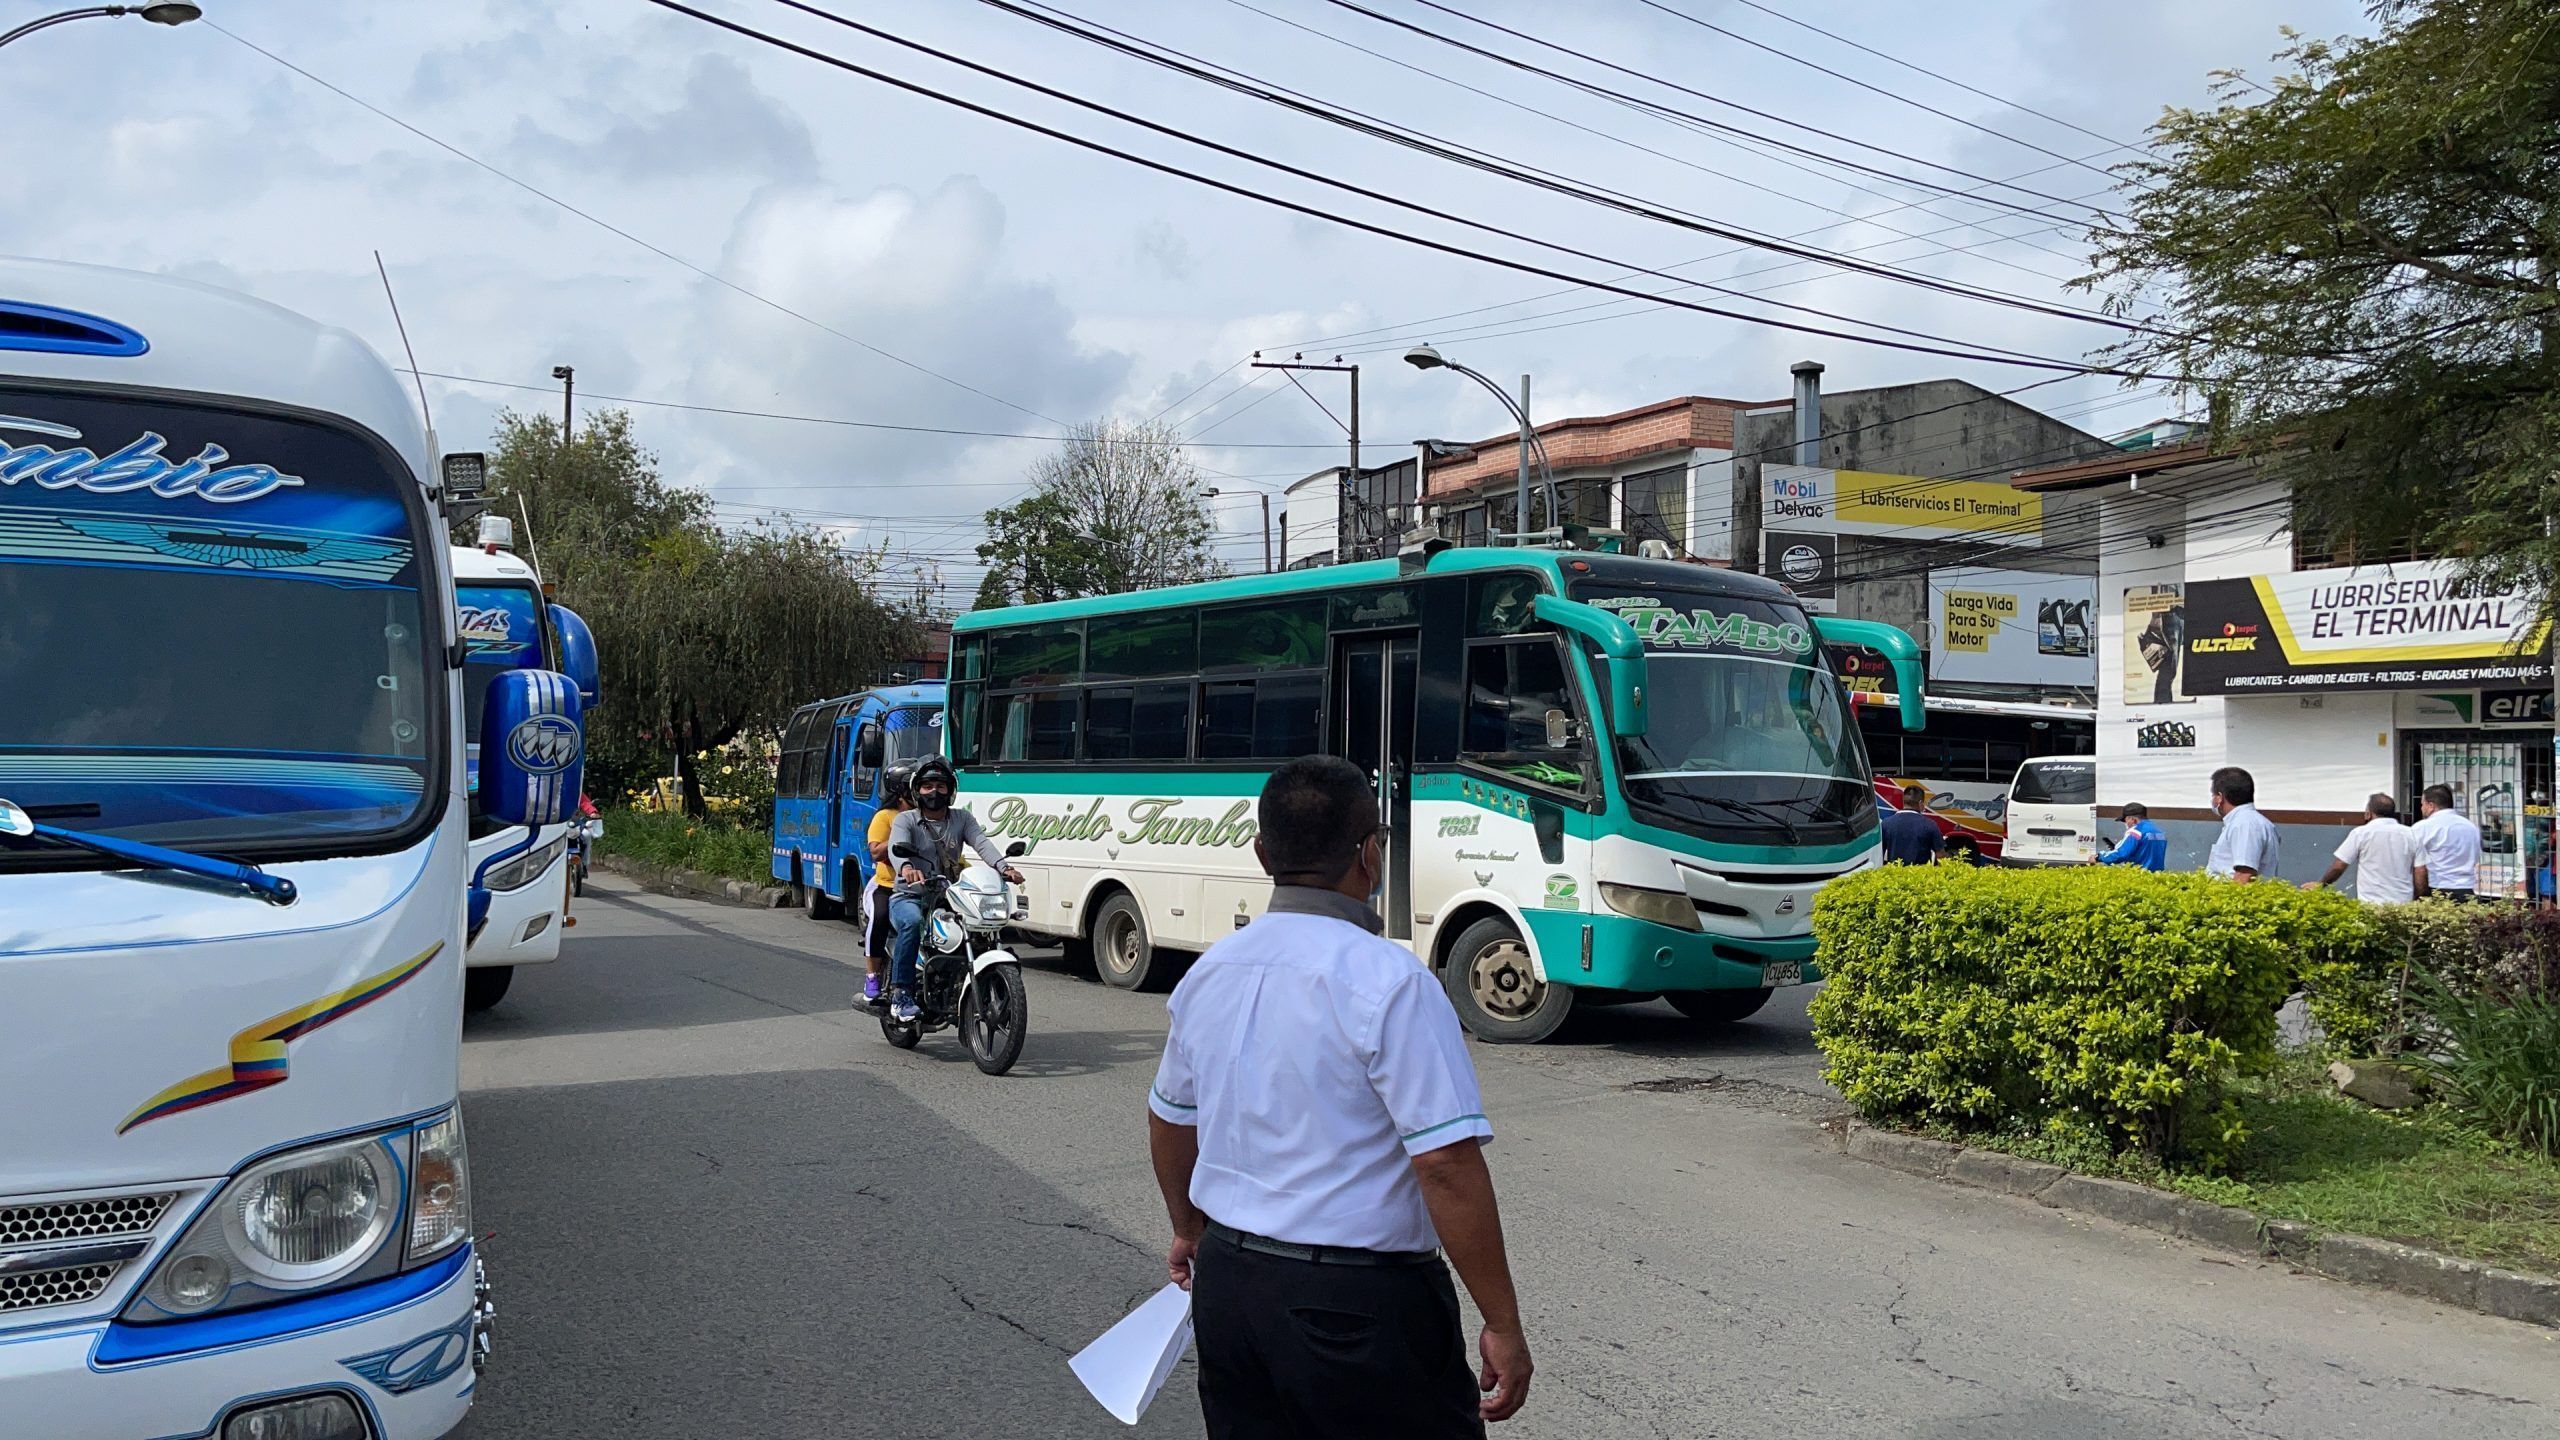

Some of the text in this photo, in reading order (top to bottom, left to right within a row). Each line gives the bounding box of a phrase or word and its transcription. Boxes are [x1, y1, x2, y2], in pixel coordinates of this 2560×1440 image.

[0, 430, 304, 503] mbio
[1774, 479, 1817, 498] Mobil
[1774, 499, 1824, 518] Delvac
[1861, 490, 2021, 516] Lubriservicios El Terminal
[1948, 593, 2013, 611] Larga Vida
[460, 608, 511, 632] TAS
[1618, 607, 1813, 655] TAMBO
[1948, 612, 1996, 628] Para Su
[2312, 602, 2511, 638] EL TERMINAL
[1948, 631, 1984, 646] Motor
[1840, 675, 1885, 693] REK
[2224, 675, 2283, 687] LUBRICANTES
[2288, 673, 2324, 685] CAMBIO
[2324, 673, 2336, 684] DE
[2337, 672, 2370, 683] ACEITE
[2375, 671, 2415, 682] FILTROS
[2422, 669, 2468, 681] ENGRASE
[2470, 669, 2479, 680] Y
[2478, 667, 2516, 679] MUCHO
[2517, 664, 2542, 677] MÁS
[2489, 694, 2541, 718] elf
[2434, 756, 2517, 768] PETROBRAS
[981, 796, 1258, 855] Rapido Tambo
